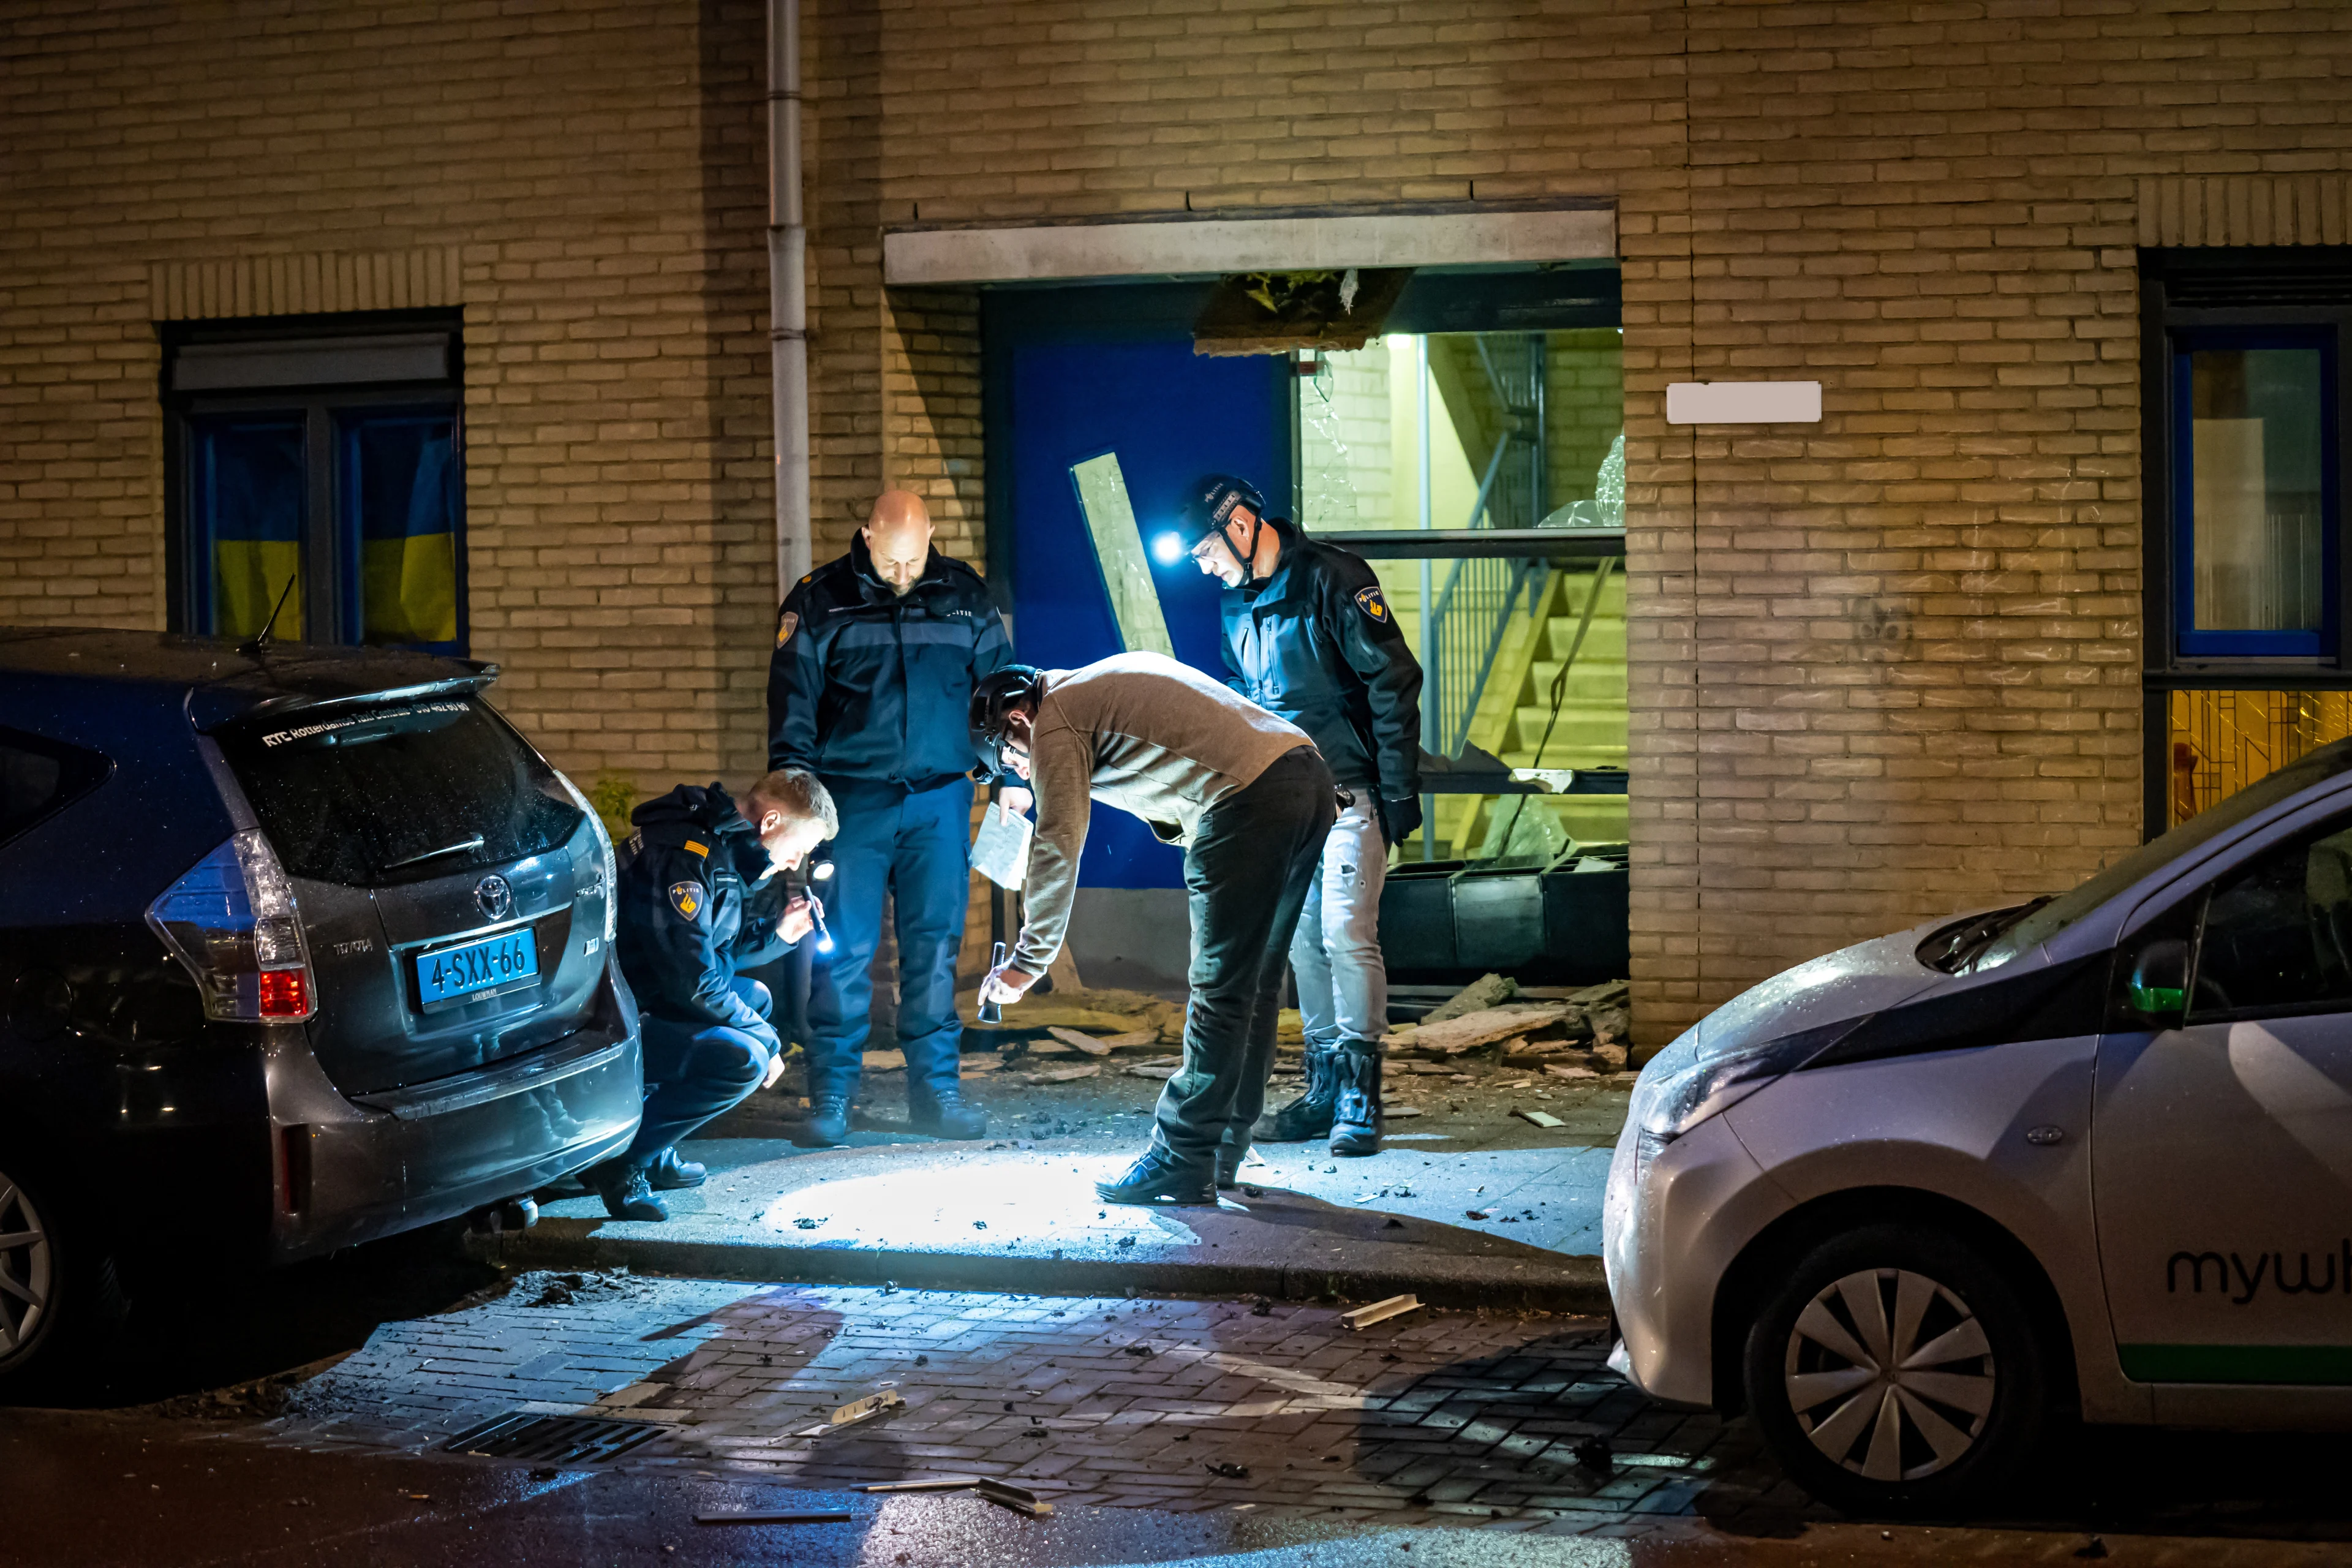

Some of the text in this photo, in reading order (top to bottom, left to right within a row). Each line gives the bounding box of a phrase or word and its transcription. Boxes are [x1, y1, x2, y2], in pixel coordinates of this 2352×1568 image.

[1359, 590, 1379, 602] POLITIE
[262, 731, 293, 747] RTC
[289, 715, 356, 739] Rotterdamse
[353, 711, 375, 723] Taxi
[374, 706, 411, 720] Centrale
[413, 703, 431, 714] 010
[430, 702, 448, 712] 462
[673, 886, 700, 895] POLITIE
[333, 938, 373, 956] TOYOTA
[432, 937, 526, 993] 4-SXX-66
[472, 987, 497, 1002] LOUWMAN
